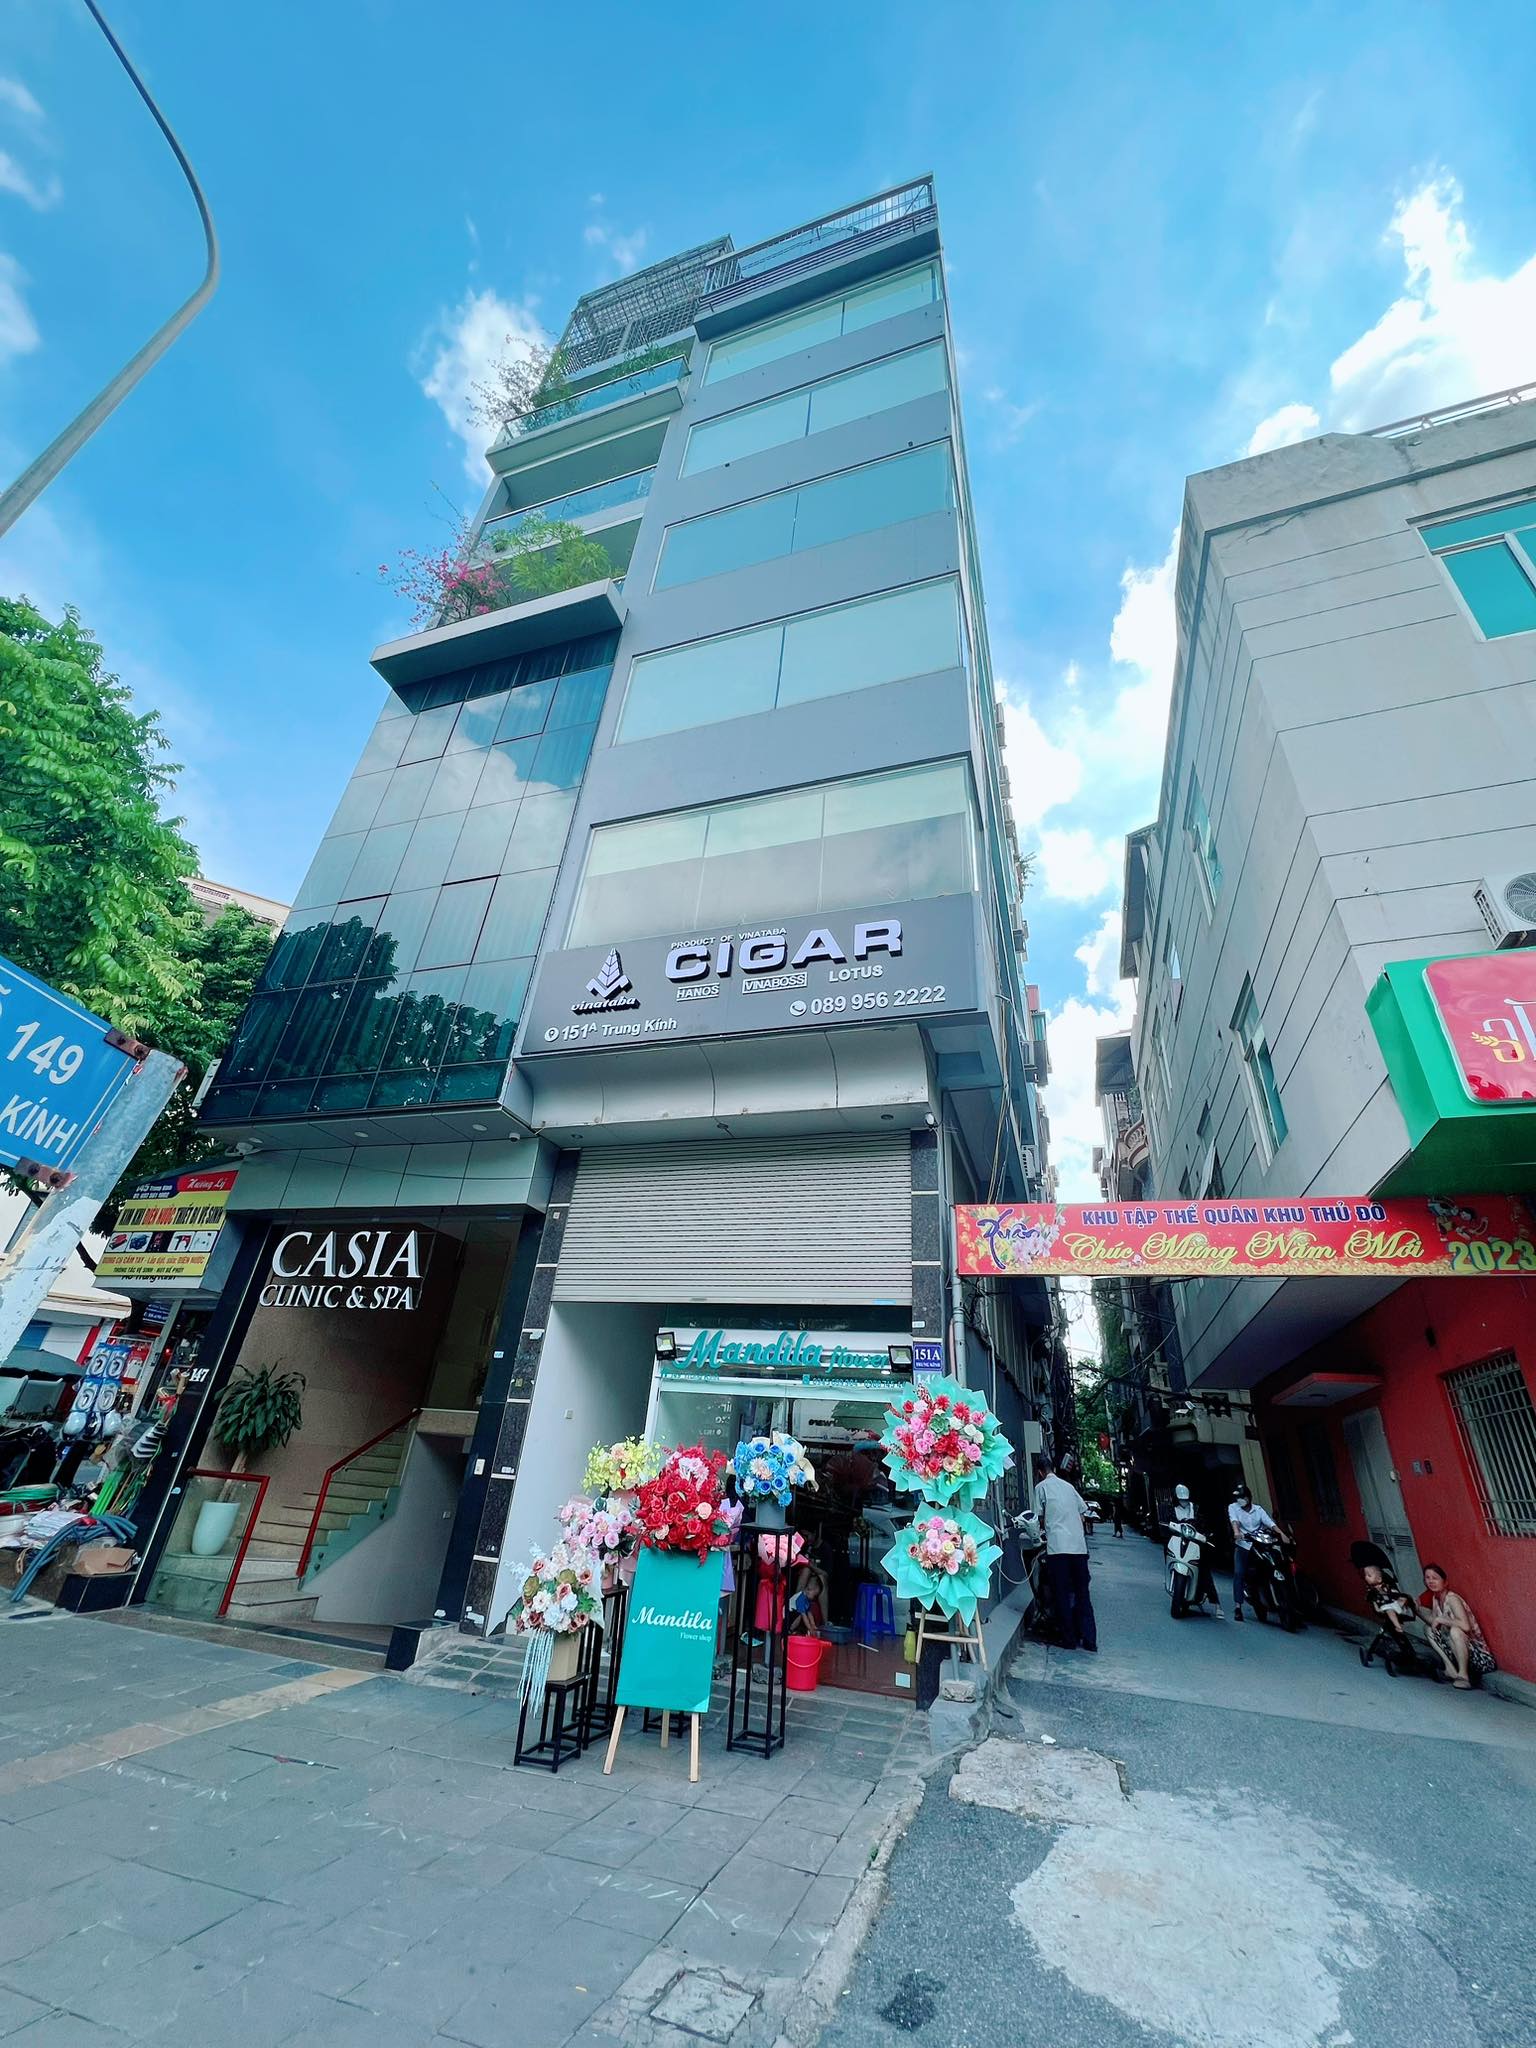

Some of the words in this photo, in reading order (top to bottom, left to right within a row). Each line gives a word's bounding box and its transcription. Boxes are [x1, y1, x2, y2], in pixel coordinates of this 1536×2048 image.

[665, 919, 902, 980] CIGAR
[671, 937, 715, 949] PRODUCT
[720, 934, 734, 943] OF
[739, 927, 787, 941] VINATABA
[676, 984, 720, 999] HANOS
[744, 974, 806, 992] VINABOSS
[829, 965, 883, 982] LOTUS
[571, 996, 638, 1012] vinataba
[810, 995, 847, 1015] 089
[851, 991, 889, 1010] 956
[893, 985, 946, 1007] 2222
[601, 1023, 641, 1037] Trung
[644, 1017, 678, 1032] Kính
[6, 1021, 85, 1086] 149
[0, 1094, 78, 1155] KÍNH
[1082, 1210, 1119, 1225] KHU
[1124, 1209, 1159, 1228] TẬP
[1163, 1203, 1200, 1225] THỂ
[1204, 1205, 1259, 1225] QUÂN
[1264, 1206, 1305, 1224] KHU
[1310, 1201, 1351, 1223] THỦ
[1355, 1201, 1386, 1222] ĐÔ
[271, 1230, 423, 1279] CASIA
[977, 1208, 1041, 1270] Xuân
[1063, 1232, 1135, 1261] Chúc
[1142, 1231, 1238, 1270] Mừng
[1245, 1230, 1337, 1260] Năm
[1344, 1229, 1425, 1260] Mới
[1450, 1240, 1536, 1273] 2023
[259, 1284, 343, 1309] CLINIC
[345, 1285, 369, 1309] &
[369, 1286, 415, 1310] SPA
[674, 1329, 824, 1369] Mandila
[915, 1348, 941, 1361] 151A
[632, 1606, 713, 1630] Mandila
[680, 1632, 698, 1641] Flower
